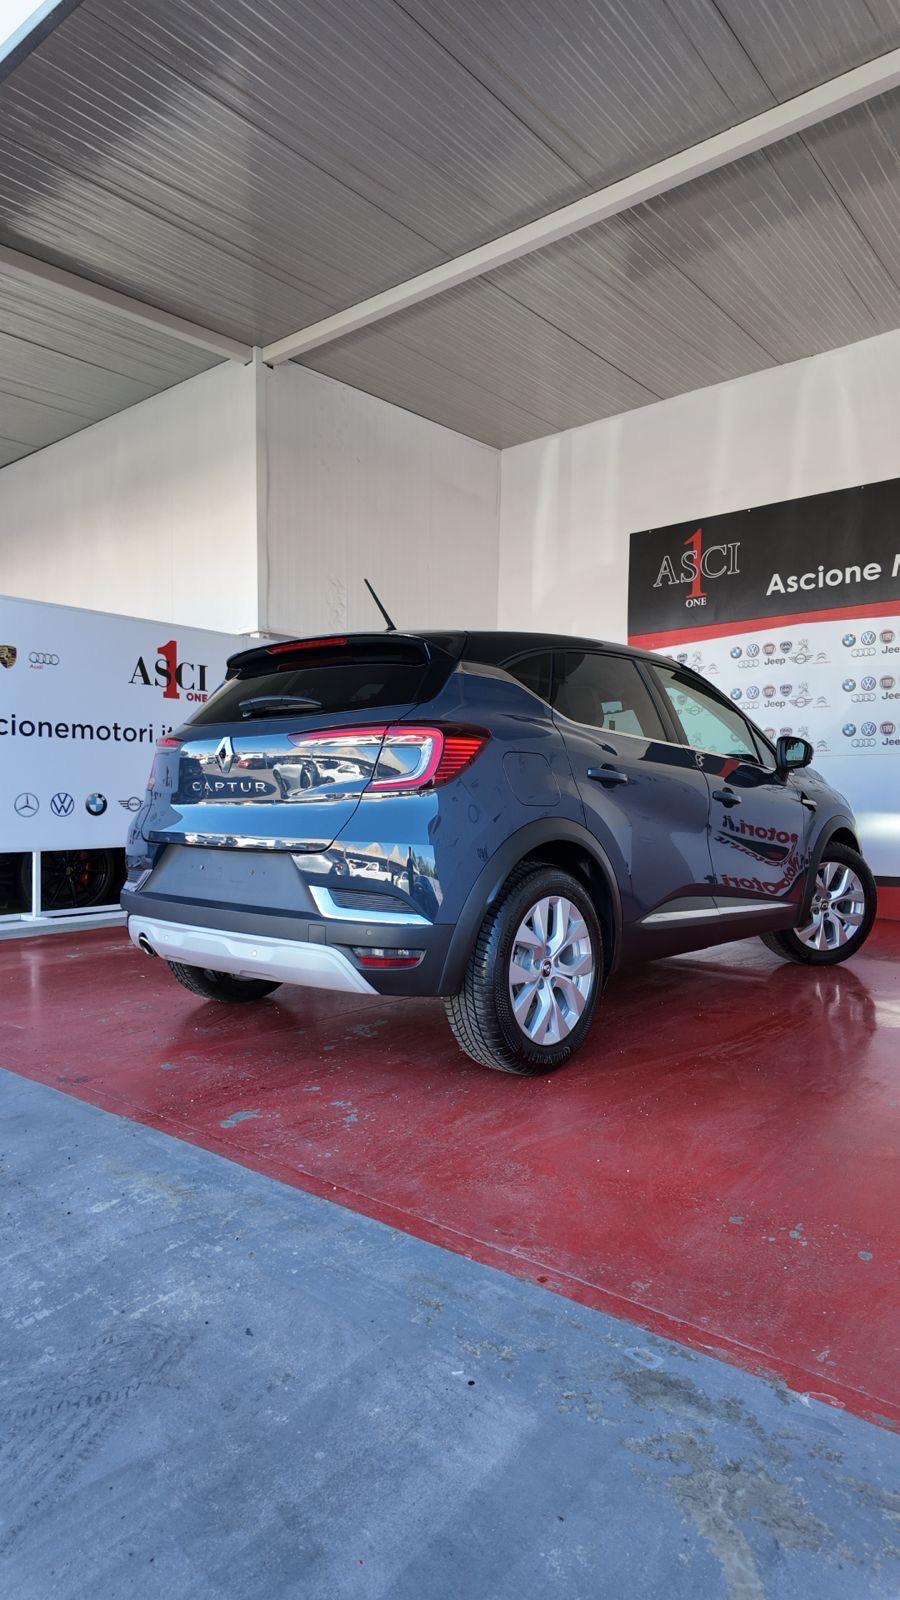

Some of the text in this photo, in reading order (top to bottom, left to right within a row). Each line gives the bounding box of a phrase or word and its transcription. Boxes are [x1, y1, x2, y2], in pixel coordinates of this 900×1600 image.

[766, 563, 882, 596] Ascione
[685, 597, 707, 608] ONE
[764, 658, 786, 666] Jeep
[187, 693, 208, 702] ONE
[764, 701, 786, 709] Jeep
[192, 781, 267, 793] CAPTUR
